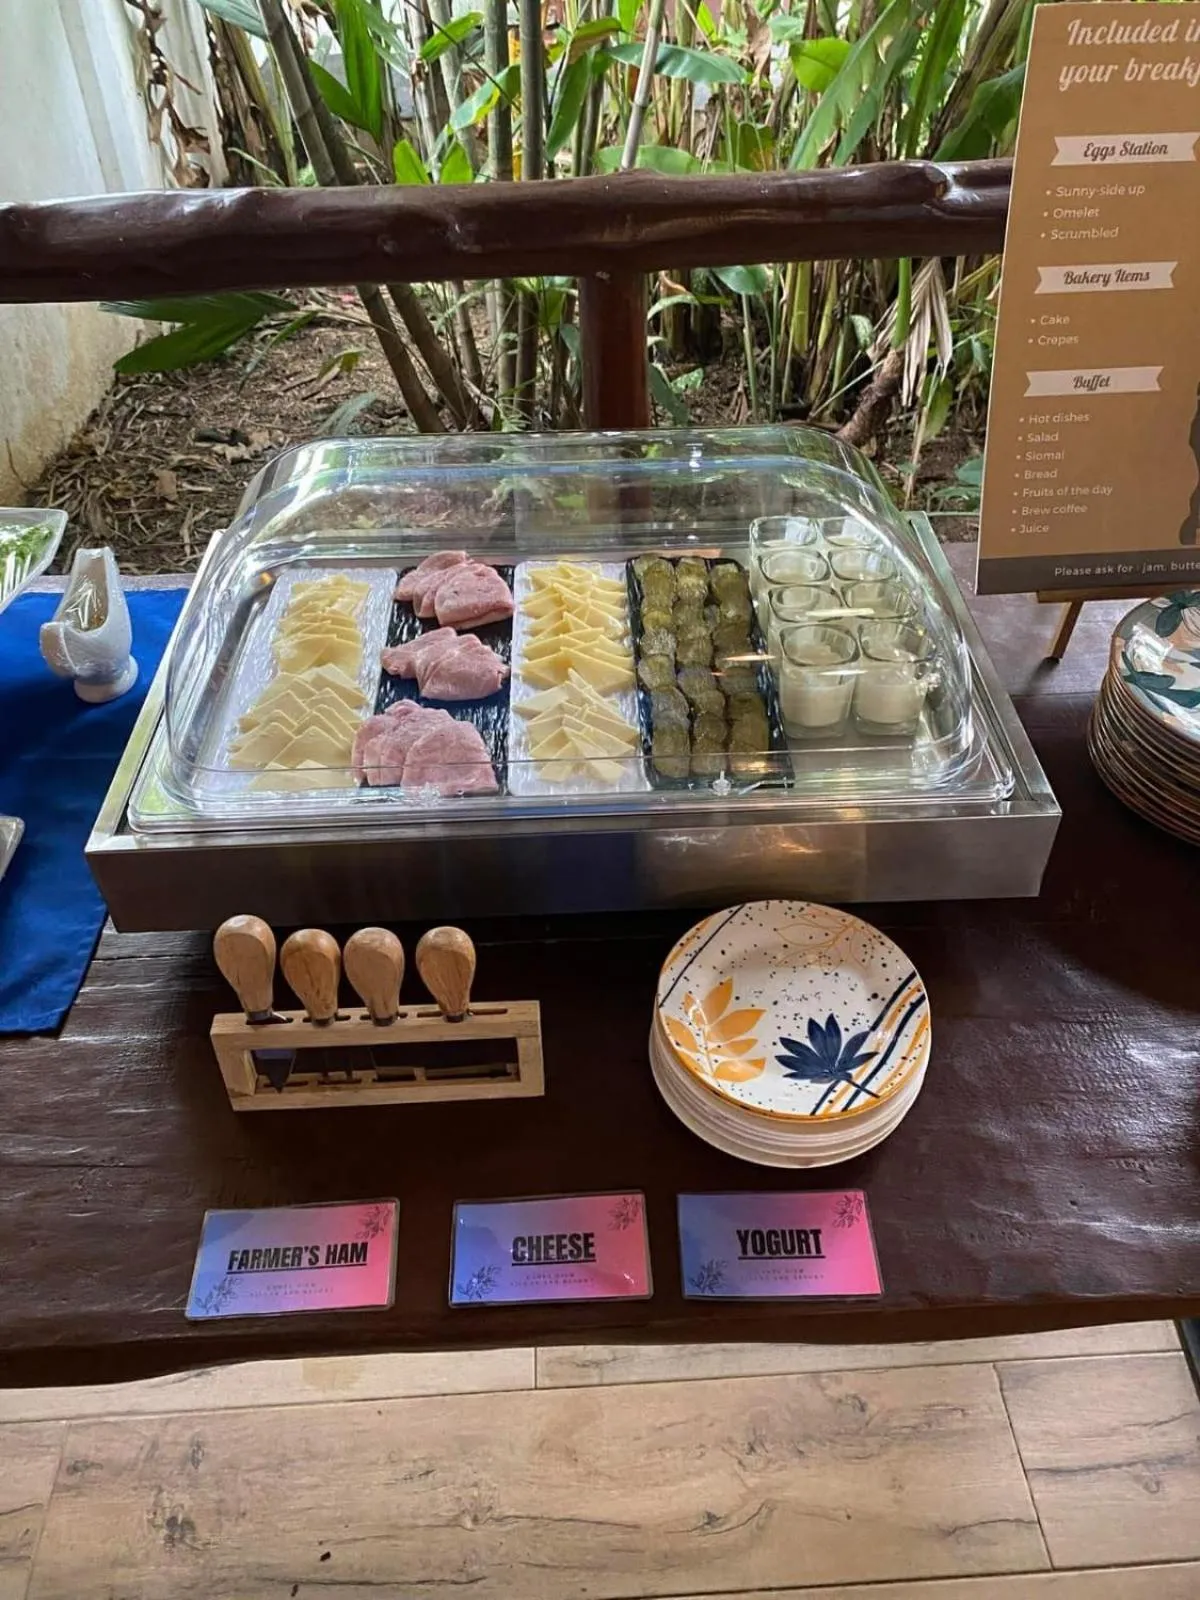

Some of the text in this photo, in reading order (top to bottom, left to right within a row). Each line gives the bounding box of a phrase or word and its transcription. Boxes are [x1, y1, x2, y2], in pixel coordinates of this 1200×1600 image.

[1067, 18, 1180, 45] Included
[1058, 64, 1118, 91] your
[1083, 141, 1168, 161] Eggs Station
[1055, 183, 1146, 199] Sunny-side up
[1053, 206, 1100, 219] Omelet
[1063, 268, 1150, 287] Bakery Items
[1040, 314, 1070, 325] Cake
[1038, 335, 1079, 347] Crepes
[1073, 374, 1111, 391] Buffet
[1028, 412, 1090, 424] Hot dishes
[1027, 432, 1059, 442] Salad
[1025, 449, 1065, 461] Siomai
[1024, 468, 1058, 480] Bread
[1022, 484, 1113, 497] Fruits of the day
[1021, 503, 1088, 516] Brew coffee
[1019, 524, 1050, 534] Juice
[1054, 566, 1091, 577] Please
[1095, 565, 1113, 575] ask
[1117, 563, 1134, 574] for
[512, 1232, 596, 1262] CHEESE
[736, 1229, 823, 1256] YOGURT
[227, 1242, 369, 1271] FARMER'S HAM
